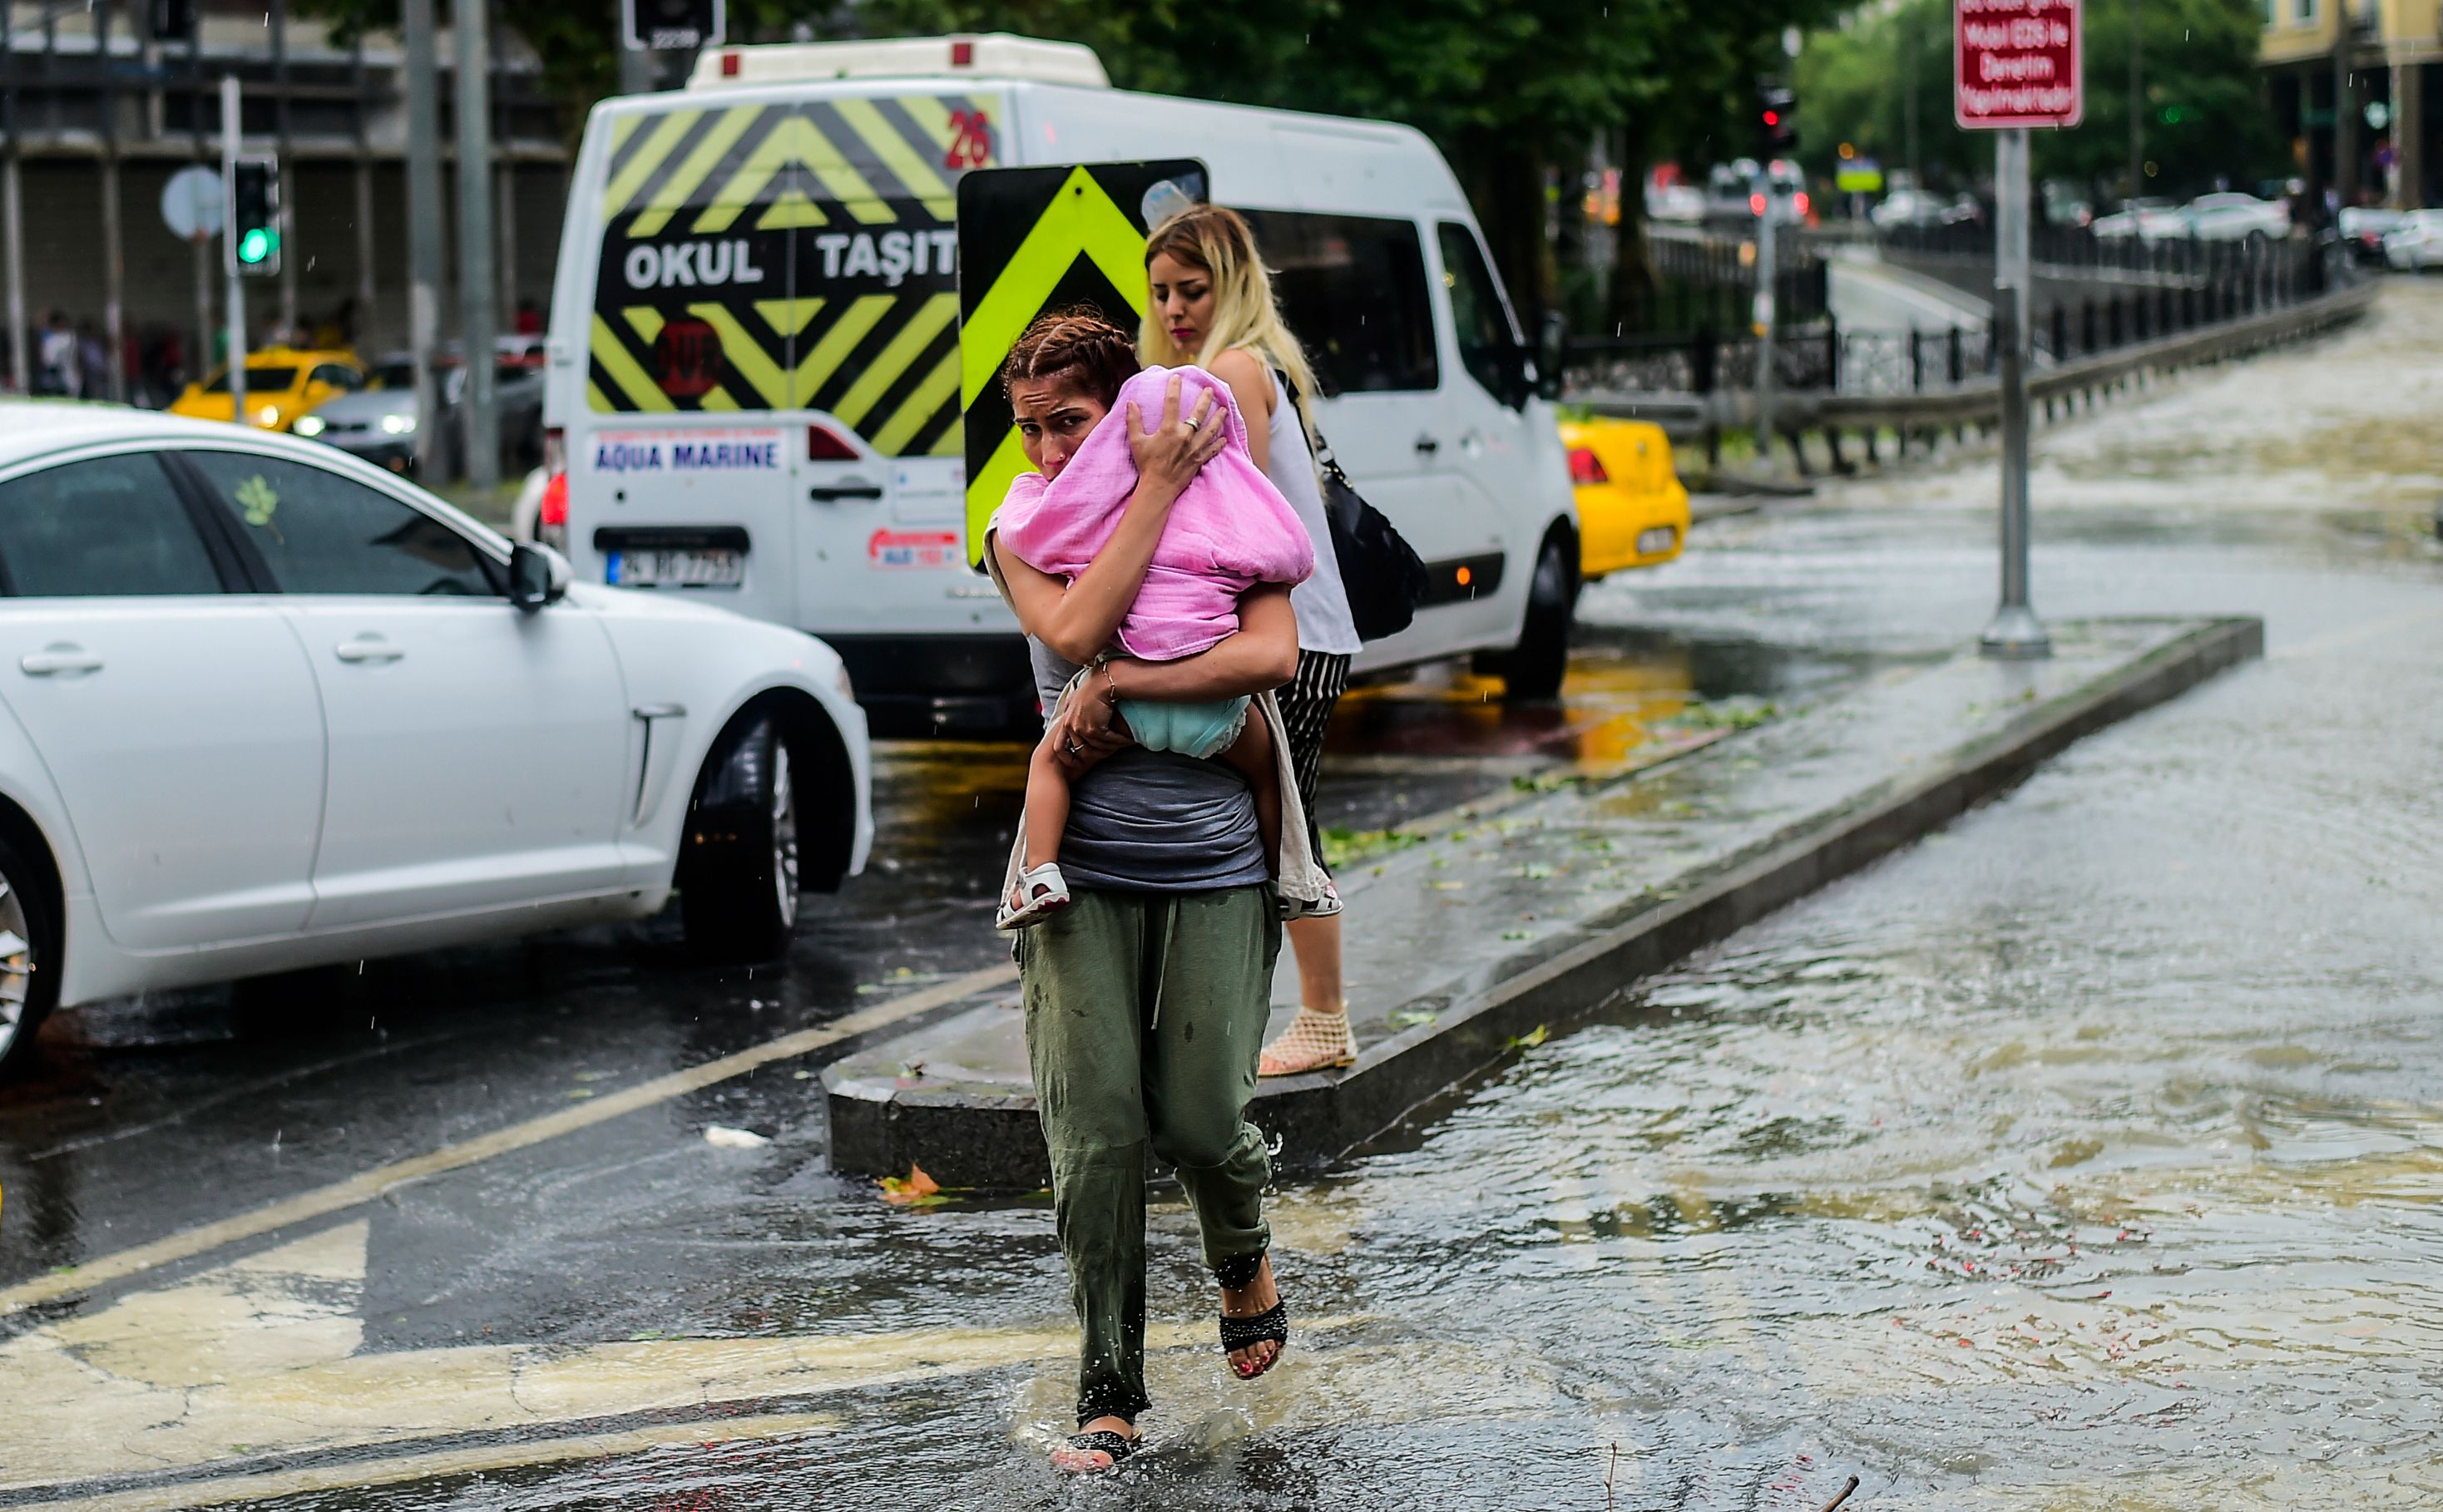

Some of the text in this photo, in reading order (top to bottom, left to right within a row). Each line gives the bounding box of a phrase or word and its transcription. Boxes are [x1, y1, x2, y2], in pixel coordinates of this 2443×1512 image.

[944, 110, 991, 170] 26
[625, 240, 764, 289] OKUL
[595, 442, 779, 471] AQUA MARINE
